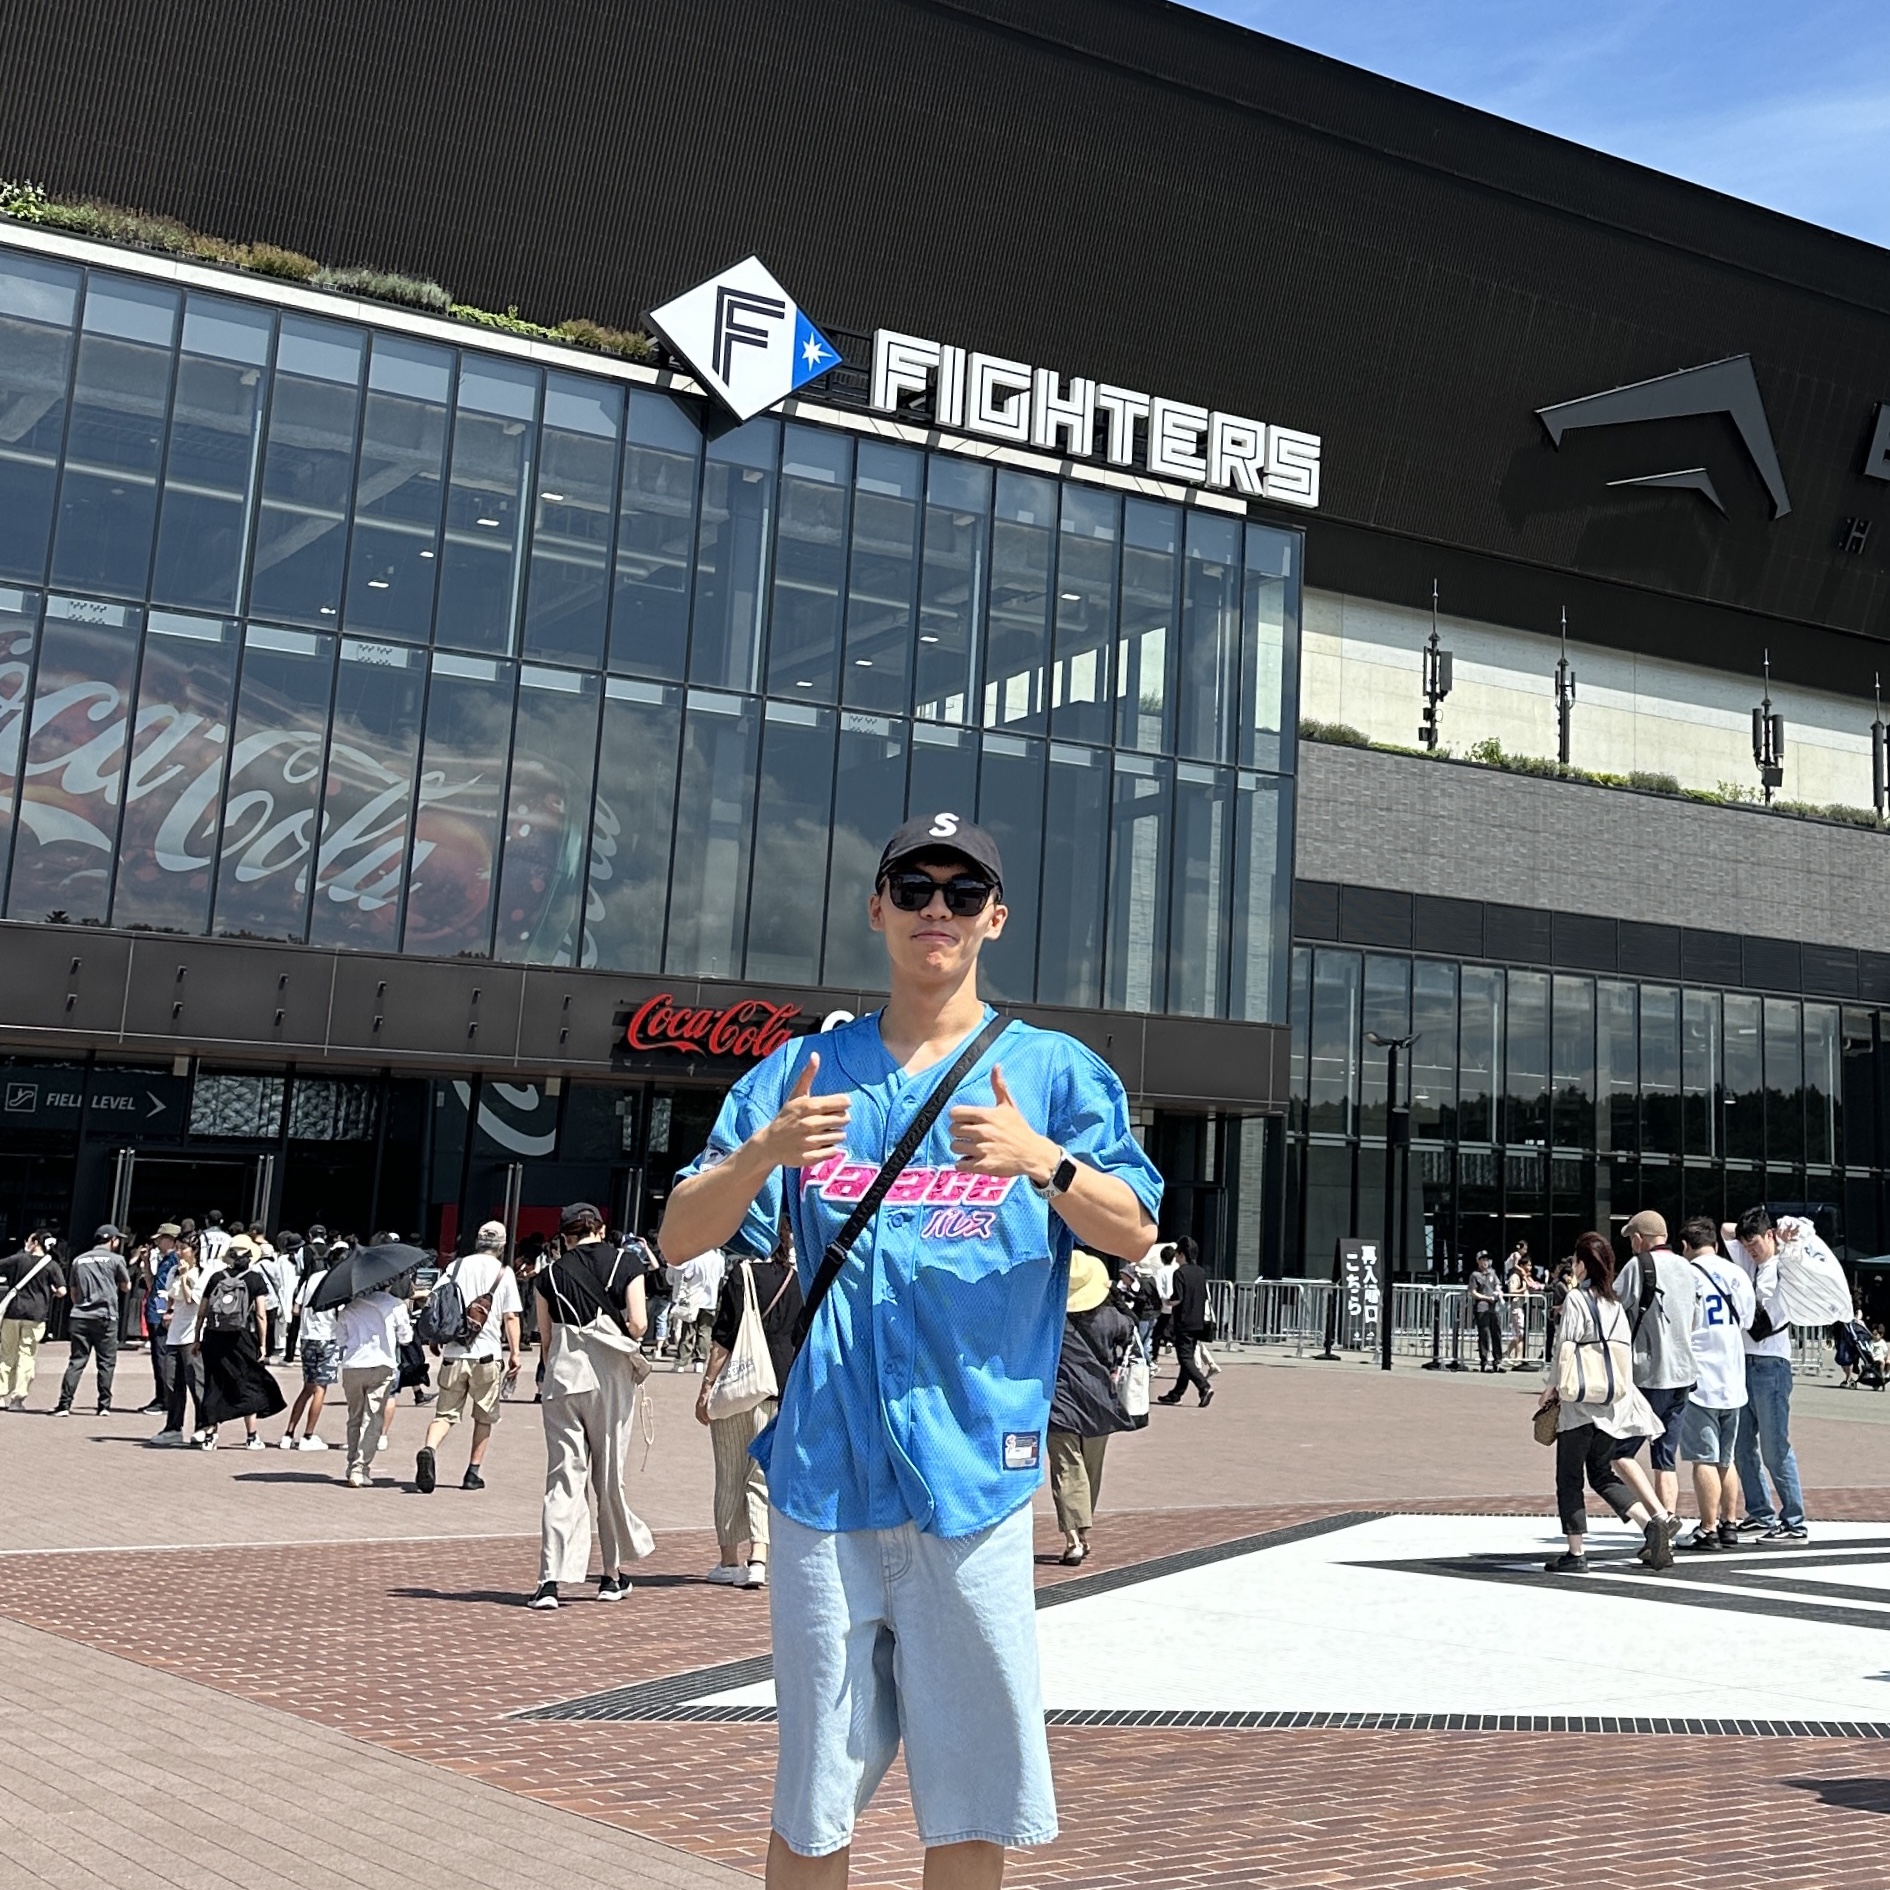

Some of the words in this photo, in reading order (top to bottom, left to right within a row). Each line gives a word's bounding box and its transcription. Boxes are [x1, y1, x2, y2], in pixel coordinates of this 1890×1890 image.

[714, 286, 785, 387] F
[871, 327, 1322, 508] FIGHTERS
[928, 812, 960, 837] S
[627, 992, 805, 1057] Coca-Cola
[91, 1095, 136, 1111] LEVEL
[1346, 1252, 1362, 1316] こちら
